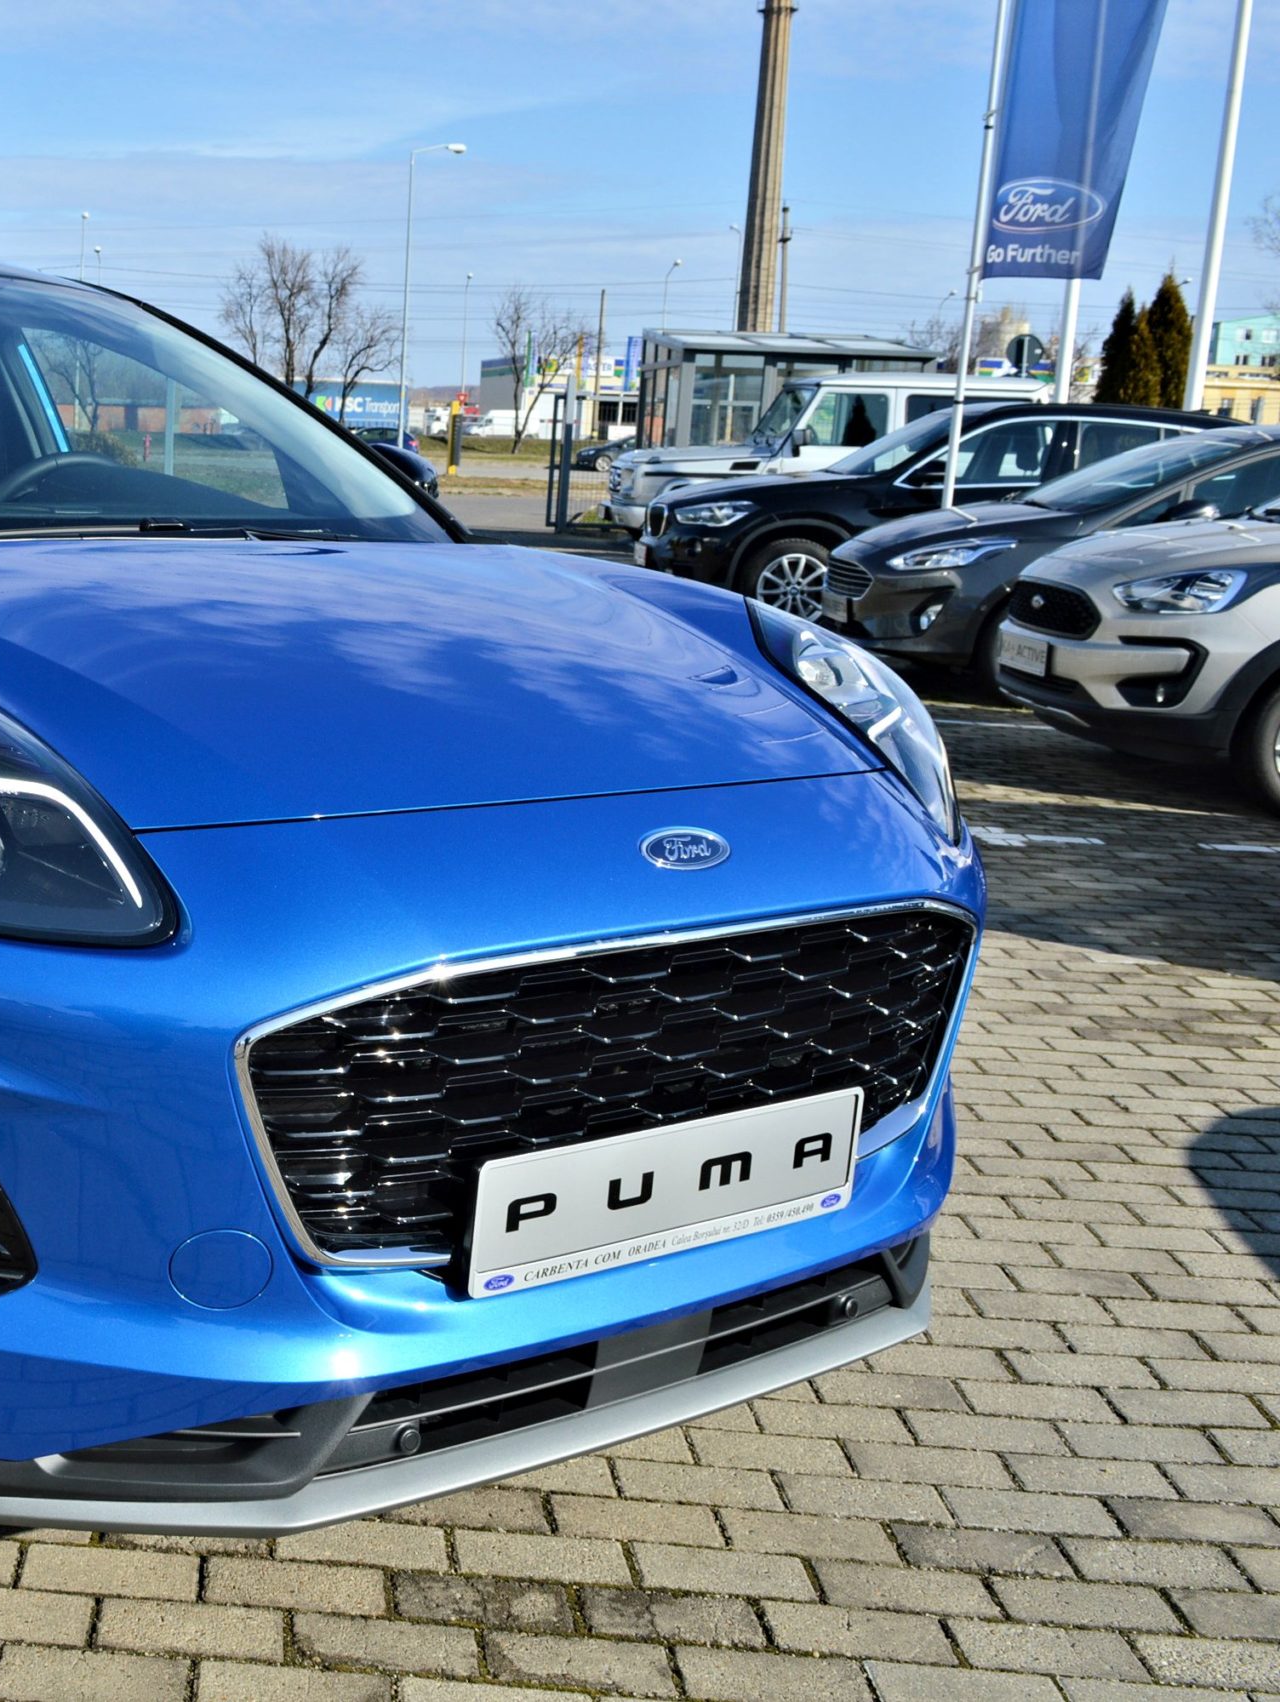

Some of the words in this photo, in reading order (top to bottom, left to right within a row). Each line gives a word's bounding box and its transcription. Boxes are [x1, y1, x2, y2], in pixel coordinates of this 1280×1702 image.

[999, 186, 1077, 223] Ford
[986, 244, 1005, 264] Go
[1006, 243, 1080, 265] Further
[662, 835, 712, 861] Ford
[523, 1257, 589, 1283] CARBENTA
[593, 1249, 623, 1266] COM
[627, 1238, 667, 1257] ORADEA
